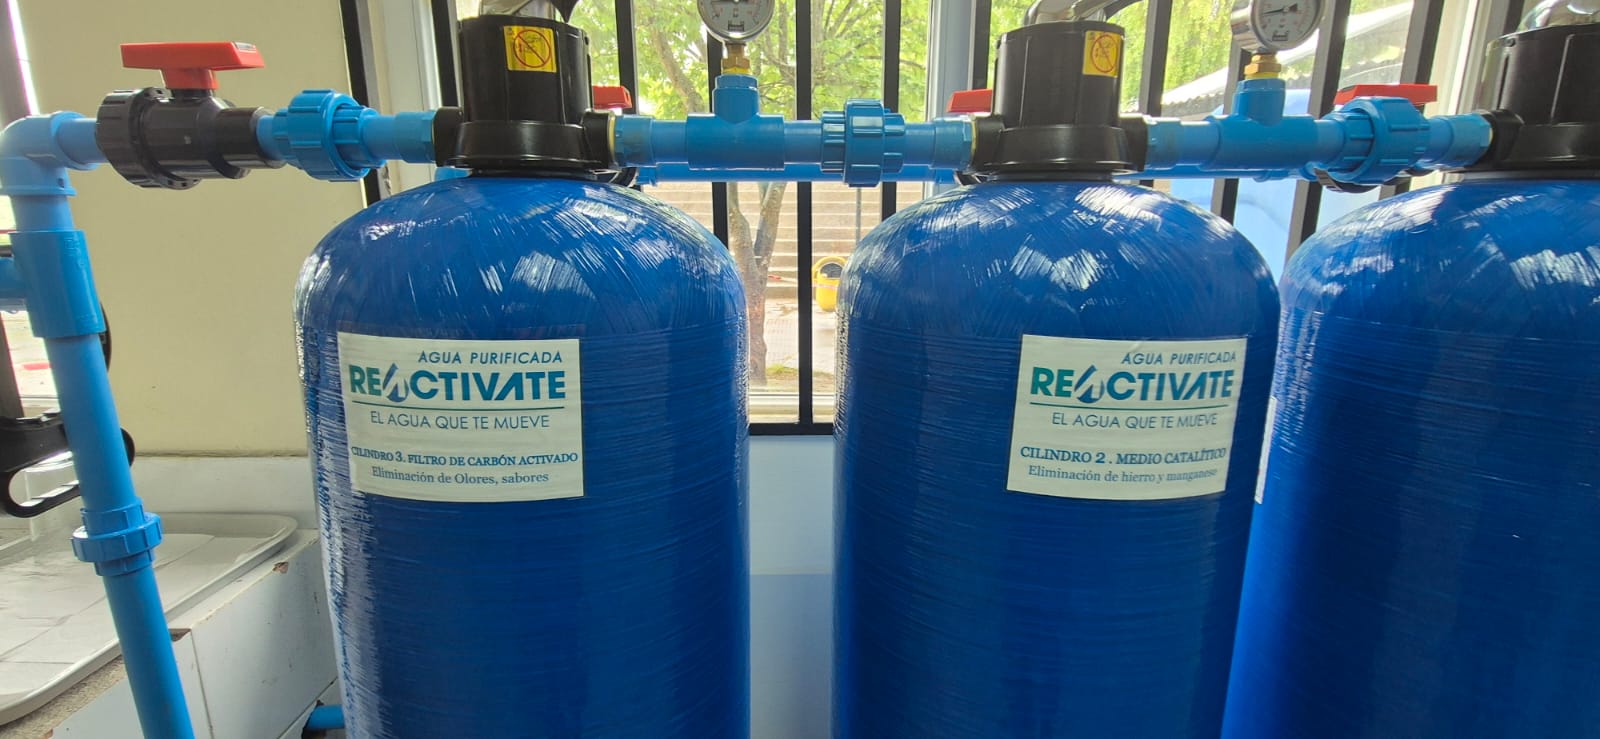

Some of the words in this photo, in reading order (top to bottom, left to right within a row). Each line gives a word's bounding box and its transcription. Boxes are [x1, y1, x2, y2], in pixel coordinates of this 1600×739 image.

[418, 351, 461, 363] AGUA
[470, 352, 562, 364] PURIFICADA
[1121, 353, 1162, 365] AGUA
[1170, 352, 1236, 365] PURIFICADA
[371, 411, 383, 424] EL
[387, 413, 431, 428] AGUA
[435, 416, 468, 429] QUE
[474, 416, 488, 429] TE
[494, 415, 549, 429] MUEVE
[1052, 412, 1067, 425] EL
[1074, 415, 1120, 428] AGUA
[1125, 416, 1156, 429] QUE
[1161, 417, 1174, 429] TE
[1177, 413, 1218, 428] MUEVE
[351, 446, 394, 461] CILINDRO
[408, 455, 445, 465] FILTRO
[449, 456, 465, 466] DE
[468, 454, 516, 466] CARBÓN
[518, 452, 578, 465] ACTIVADO
[1020, 446, 1091, 463] CILINDRO
[1116, 453, 1162, 465] MEDIO
[372, 466, 434, 483] Eliminación
[438, 473, 451, 483] de
[454, 474, 499, 485] Olores,
[501, 471, 549, 484] sabores
[1028, 465, 1100, 482] Eliminación
[1104, 470, 1119, 482] de
[1121, 472, 1156, 482] hierro
[1157, 474, 1163, 484] y
